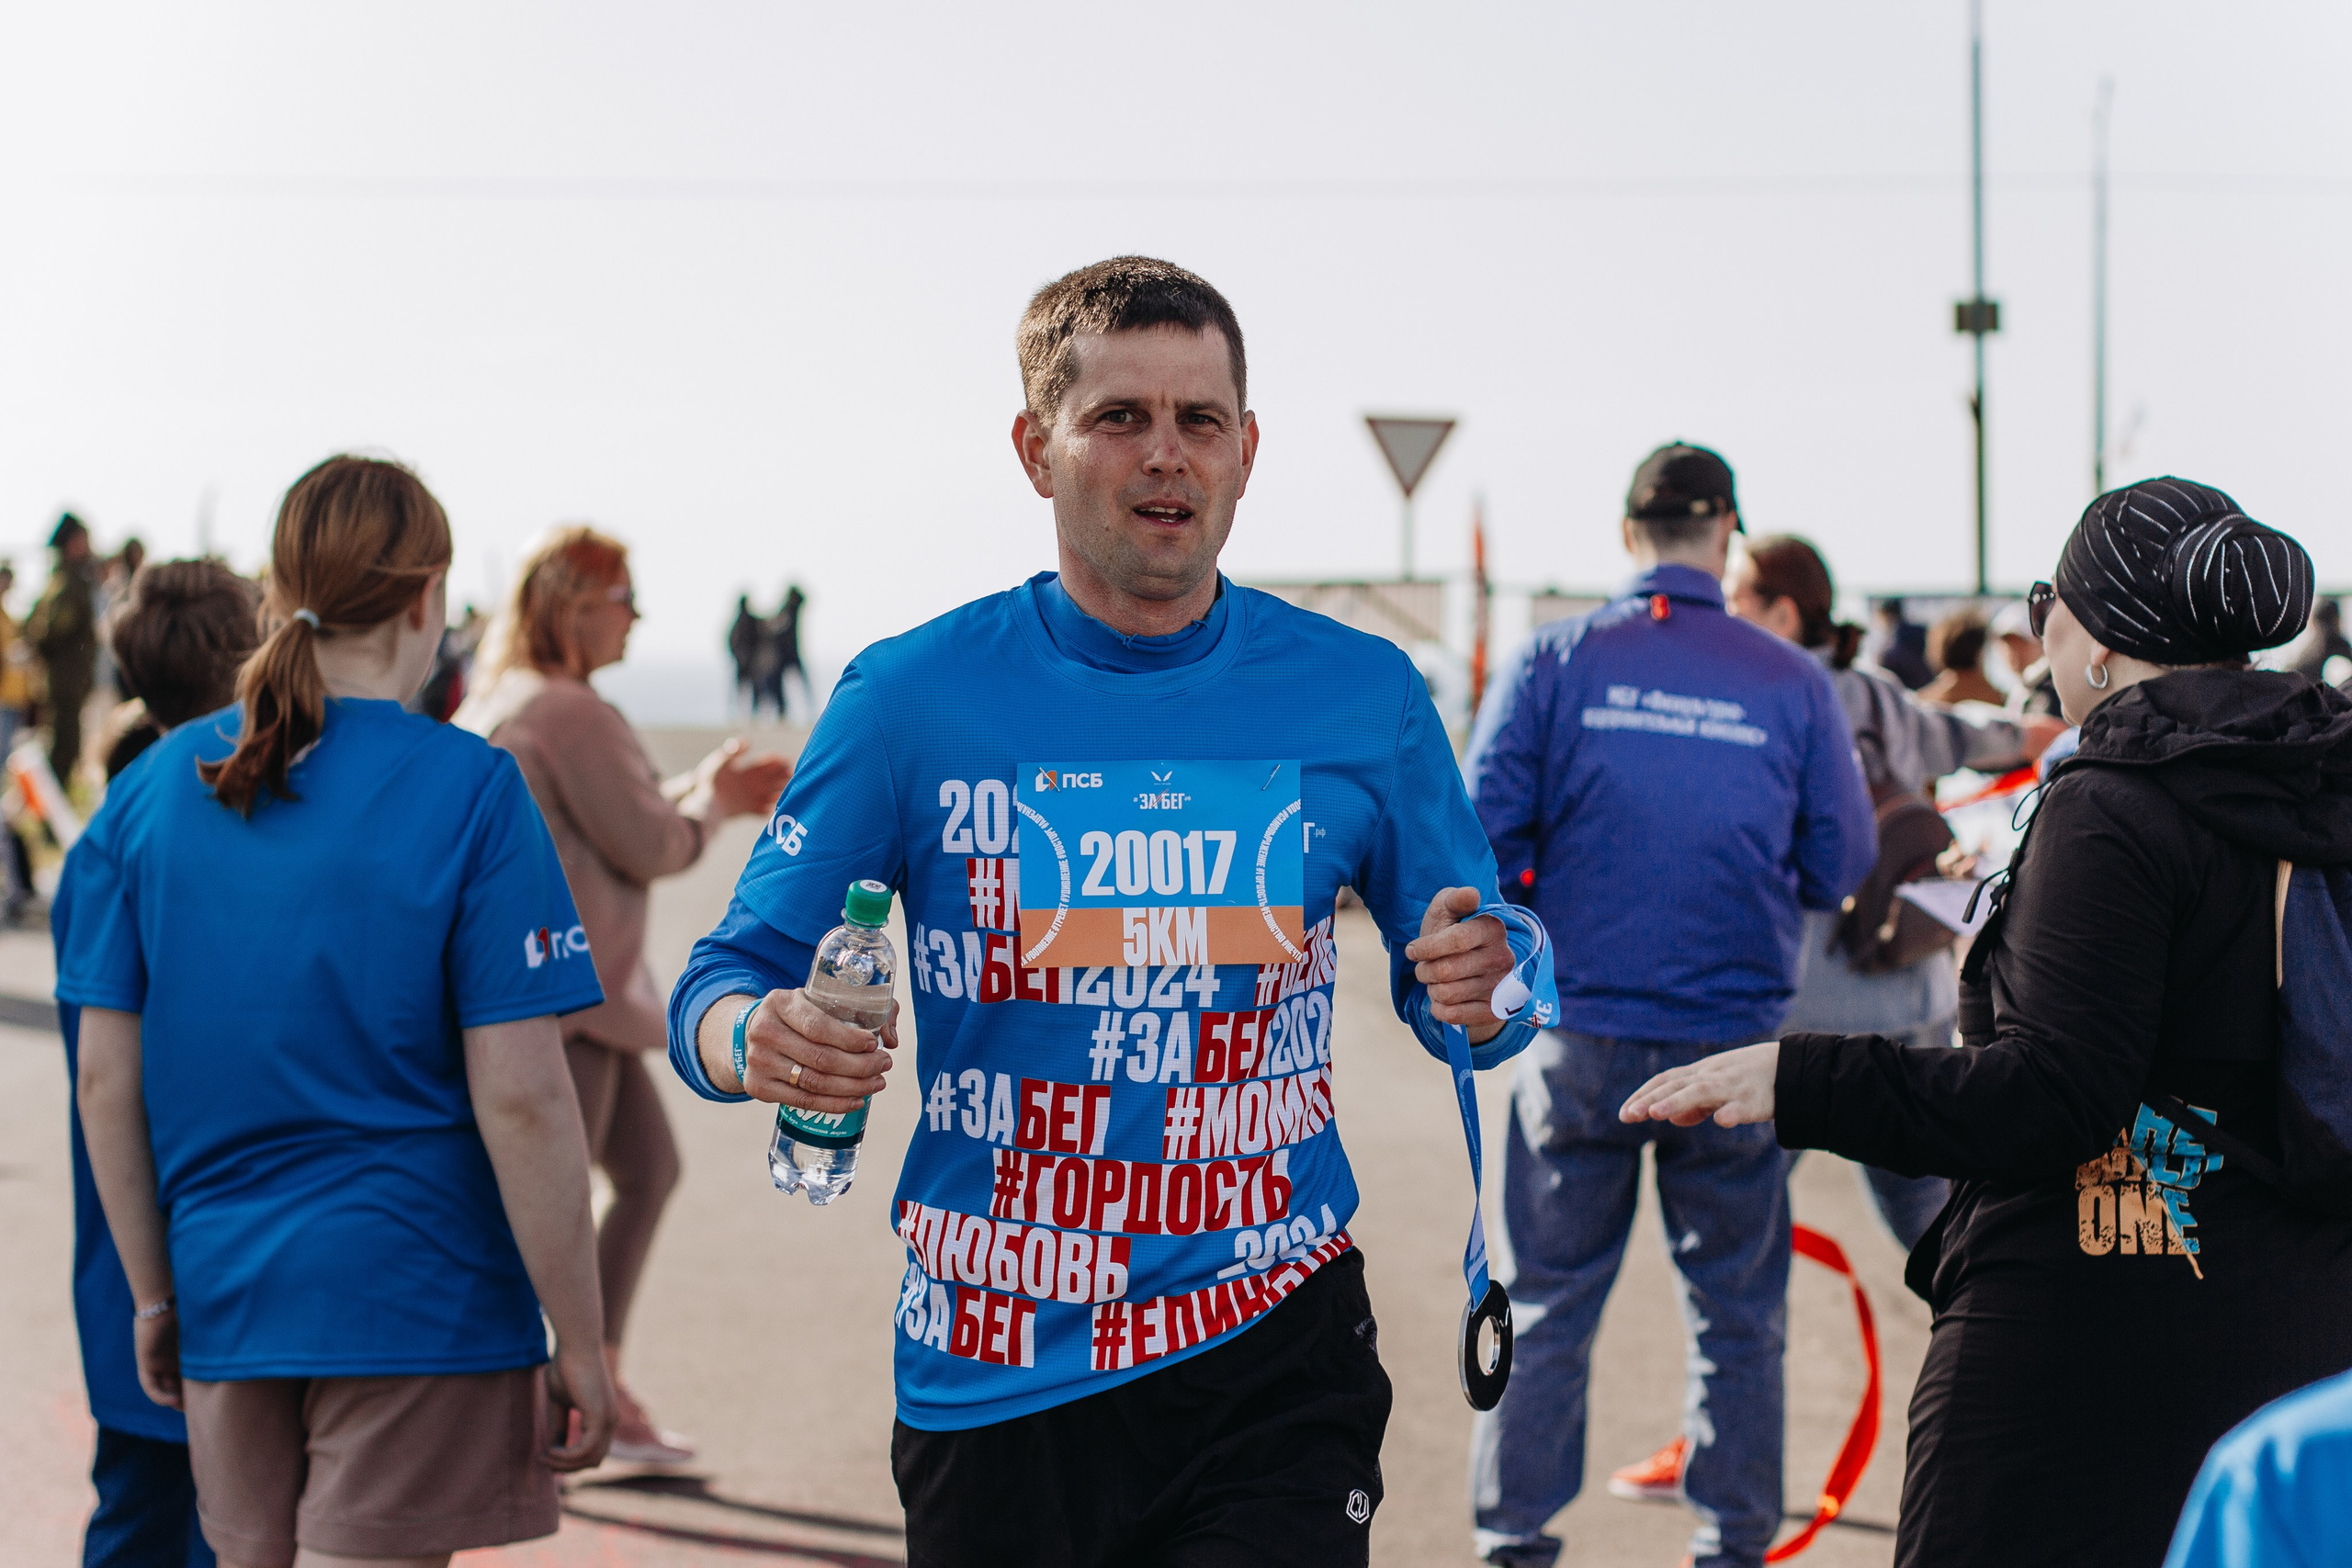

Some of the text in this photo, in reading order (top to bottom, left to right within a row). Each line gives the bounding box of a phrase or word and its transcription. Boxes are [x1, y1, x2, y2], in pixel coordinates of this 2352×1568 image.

[1062, 773, 1102, 788] ПСБ
[939, 779, 1019, 855] 20
[1044, 827, 1067, 860] #ВОСТОРГ
[1080, 829, 1237, 897] 20017
[1058, 858, 1071, 903] #УДИВЛЕНИЕ
[1255, 866, 1268, 908] #ГОРДОСТЬ
[1050, 902, 1069, 932] #ТРЕПЕТ
[1261, 906, 1286, 943] #ЕДИНСТВО
[1024, 928, 1057, 963] #ВОЛНЕНИЕ
[1282, 939, 1303, 963] #МЕЧТА
[1088, 990, 1333, 1085] #ЗАБЕГ202
[926, 1068, 1111, 1155] #ЗАБЕГ
[989, 1148, 1293, 1236] #ГОРДОСТЬ
[897, 1201, 1132, 1304] #ЛЮБОВЬ
